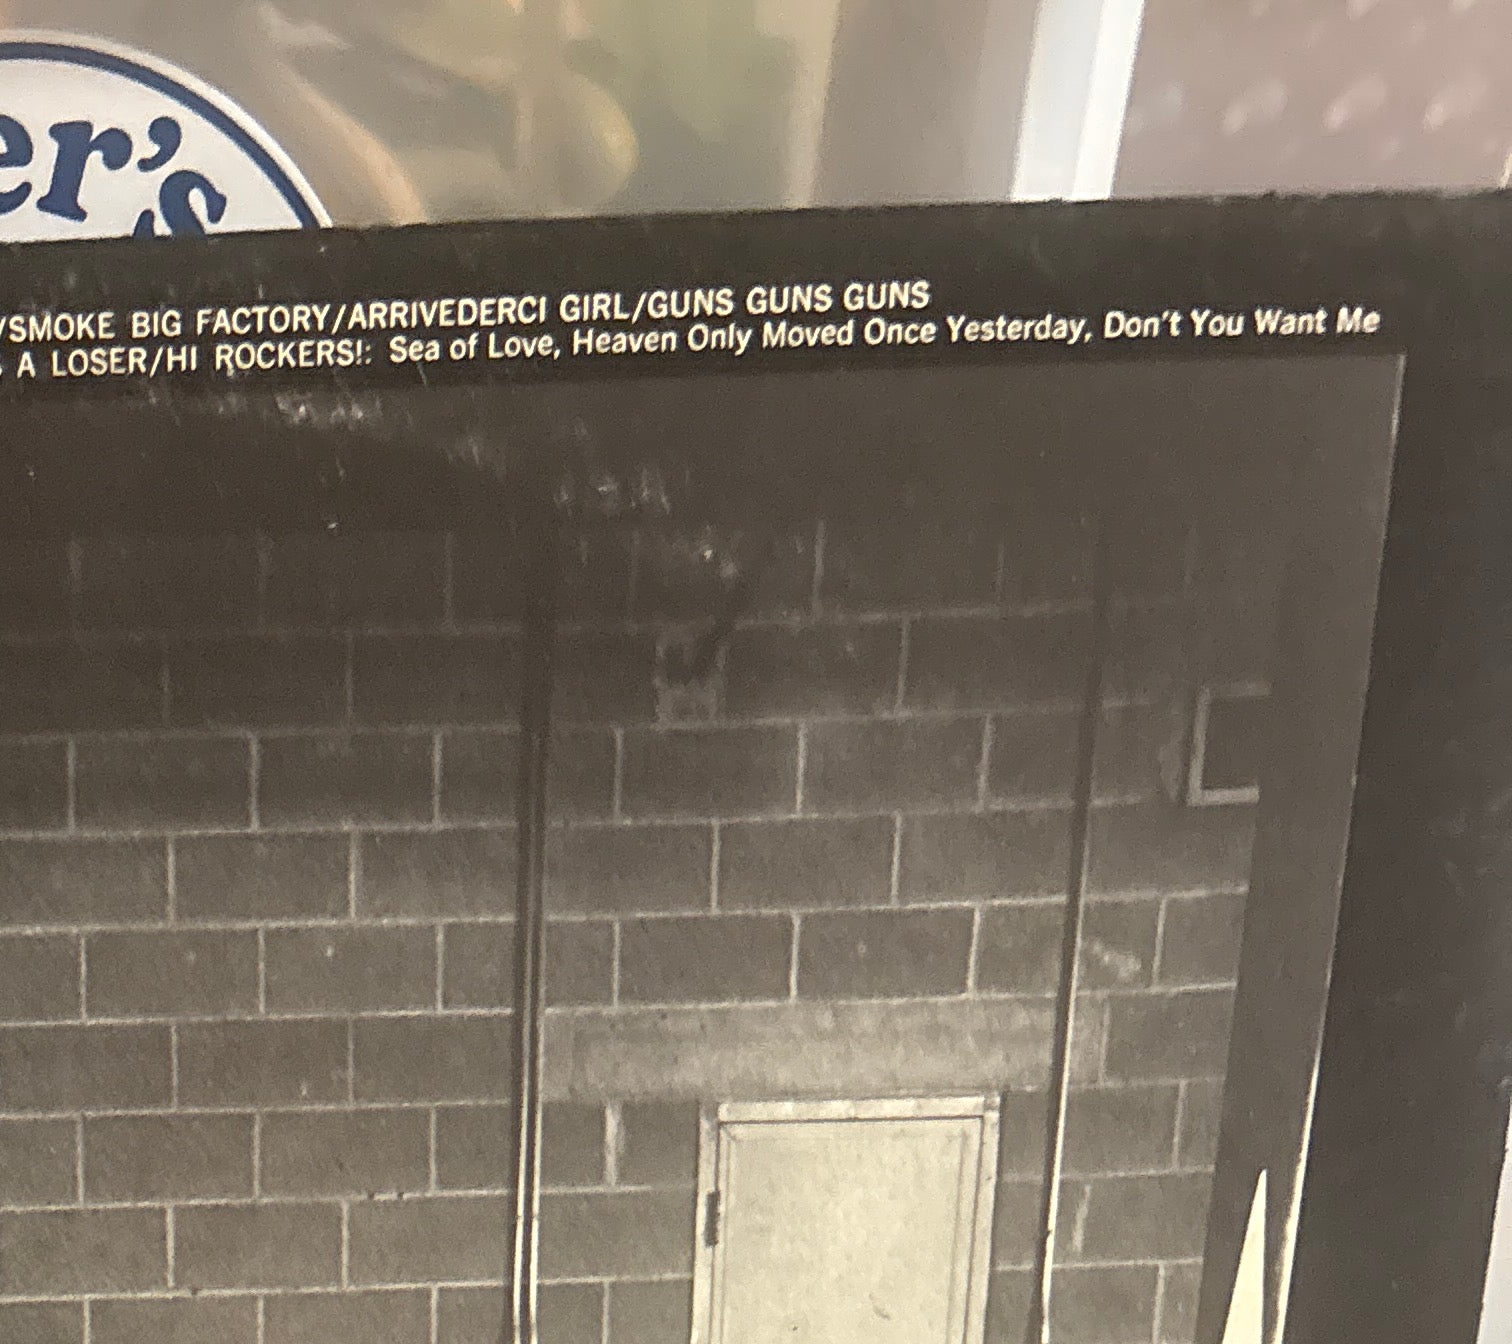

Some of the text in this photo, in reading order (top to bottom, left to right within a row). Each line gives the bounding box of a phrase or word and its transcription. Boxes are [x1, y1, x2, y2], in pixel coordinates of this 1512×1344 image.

[16, 350, 37, 379] A
[51, 344, 198, 378] LOSER/HI
[215, 338, 372, 371] ROCKERS!:
[389, 334, 441, 364] Sea
[449, 331, 480, 361] of
[488, 331, 561, 361] Love,
[572, 327, 679, 356] Heaven
[687, 322, 754, 357] Only
[762, 318, 856, 349] Moved
[863, 316, 939, 346] Once
[945, 312, 1094, 345] Yesterday,
[1103, 309, 1185, 339] Don't
[1189, 308, 1245, 337] You
[1254, 306, 1329, 336] Want
[1335, 305, 1381, 334] Me
[131, 308, 182, 339] BIG
[196, 295, 548, 336] FACTORY/ARRIVEDERCI
[559, 287, 736, 325] GIRL/GUNS
[745, 283, 834, 315] GUNS
[843, 279, 932, 312] GUNS
